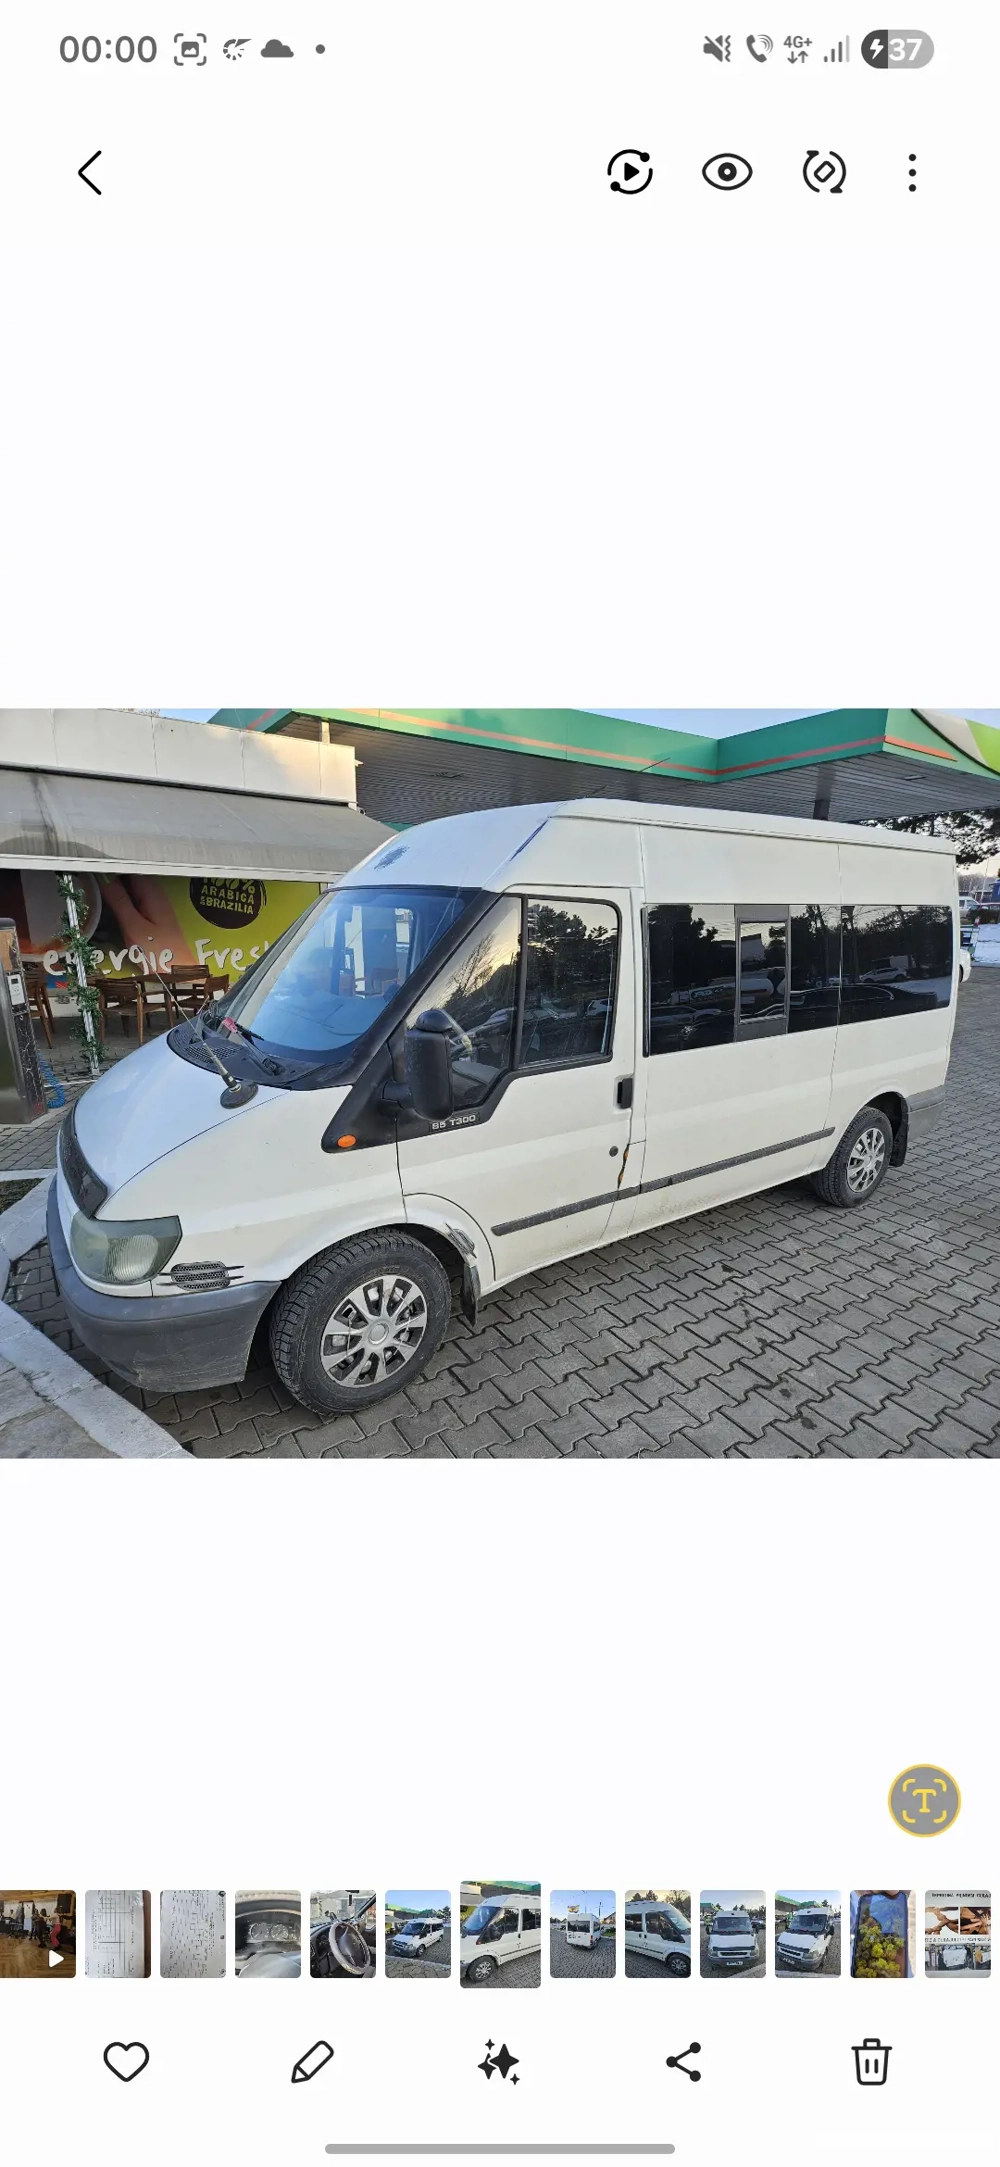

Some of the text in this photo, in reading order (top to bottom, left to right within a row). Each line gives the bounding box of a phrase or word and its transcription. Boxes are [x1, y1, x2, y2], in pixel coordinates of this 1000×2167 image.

[201, 885, 254, 904] ARABICA
[206, 896, 254, 914] BRAZILIA
[450, 1115, 476, 1126] T300
